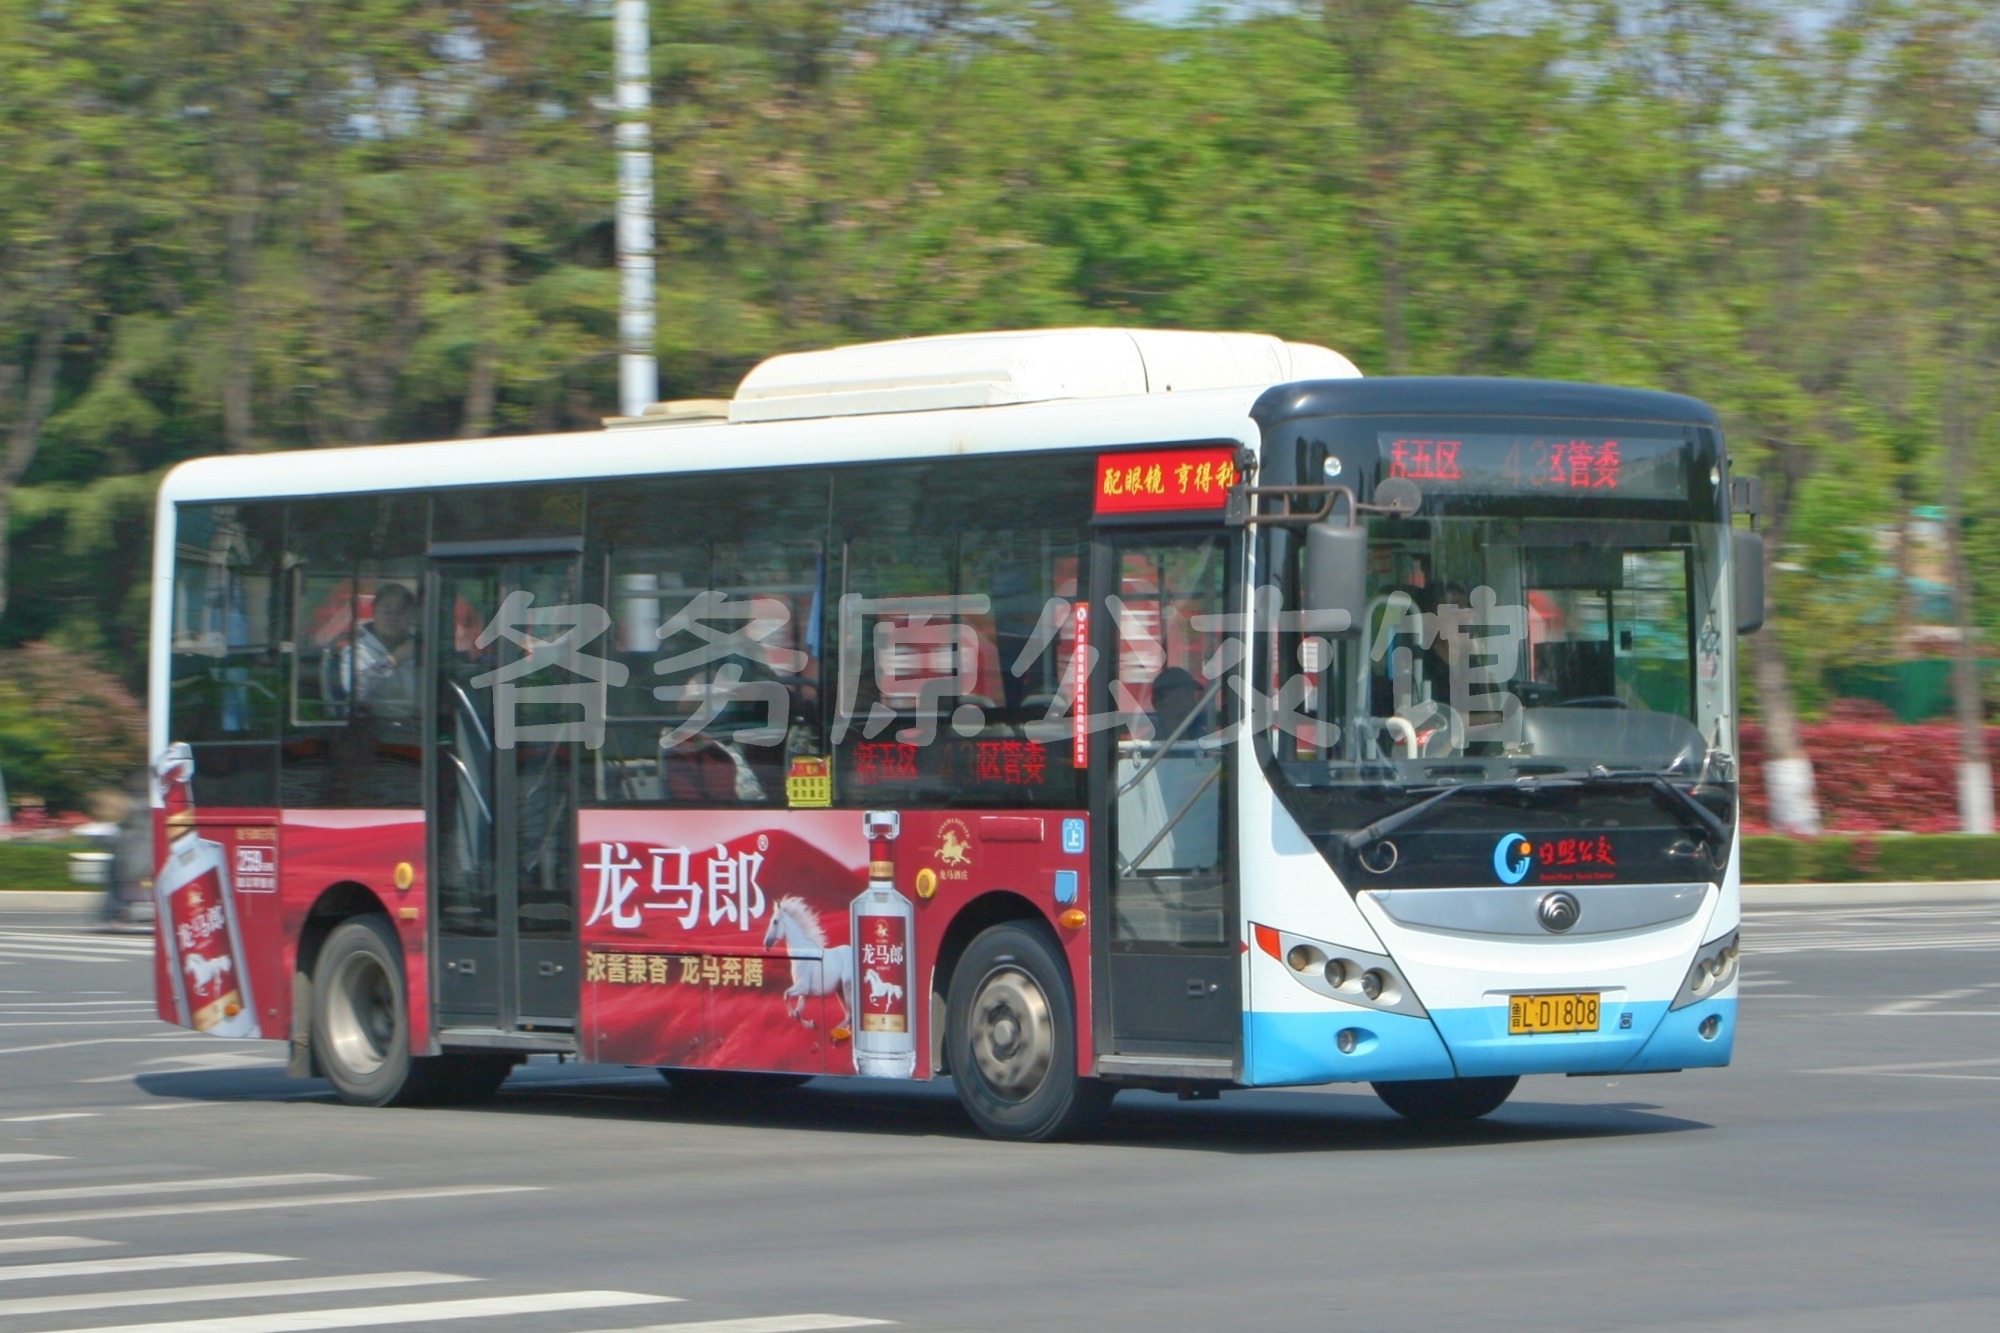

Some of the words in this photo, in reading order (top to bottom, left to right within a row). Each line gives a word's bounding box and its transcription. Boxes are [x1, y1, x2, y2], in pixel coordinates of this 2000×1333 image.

[1103, 467, 1144, 496] 配眼镜
[1174, 461, 1234, 494] 亨得利
[1068, 829, 1080, 847] 上
[583, 843, 766, 931] 龙马郎
[940, 869, 969, 880] 龙马酒庄
[862, 943, 904, 965] 龙马郎
[680, 953, 764, 987] 龙马奔腾
